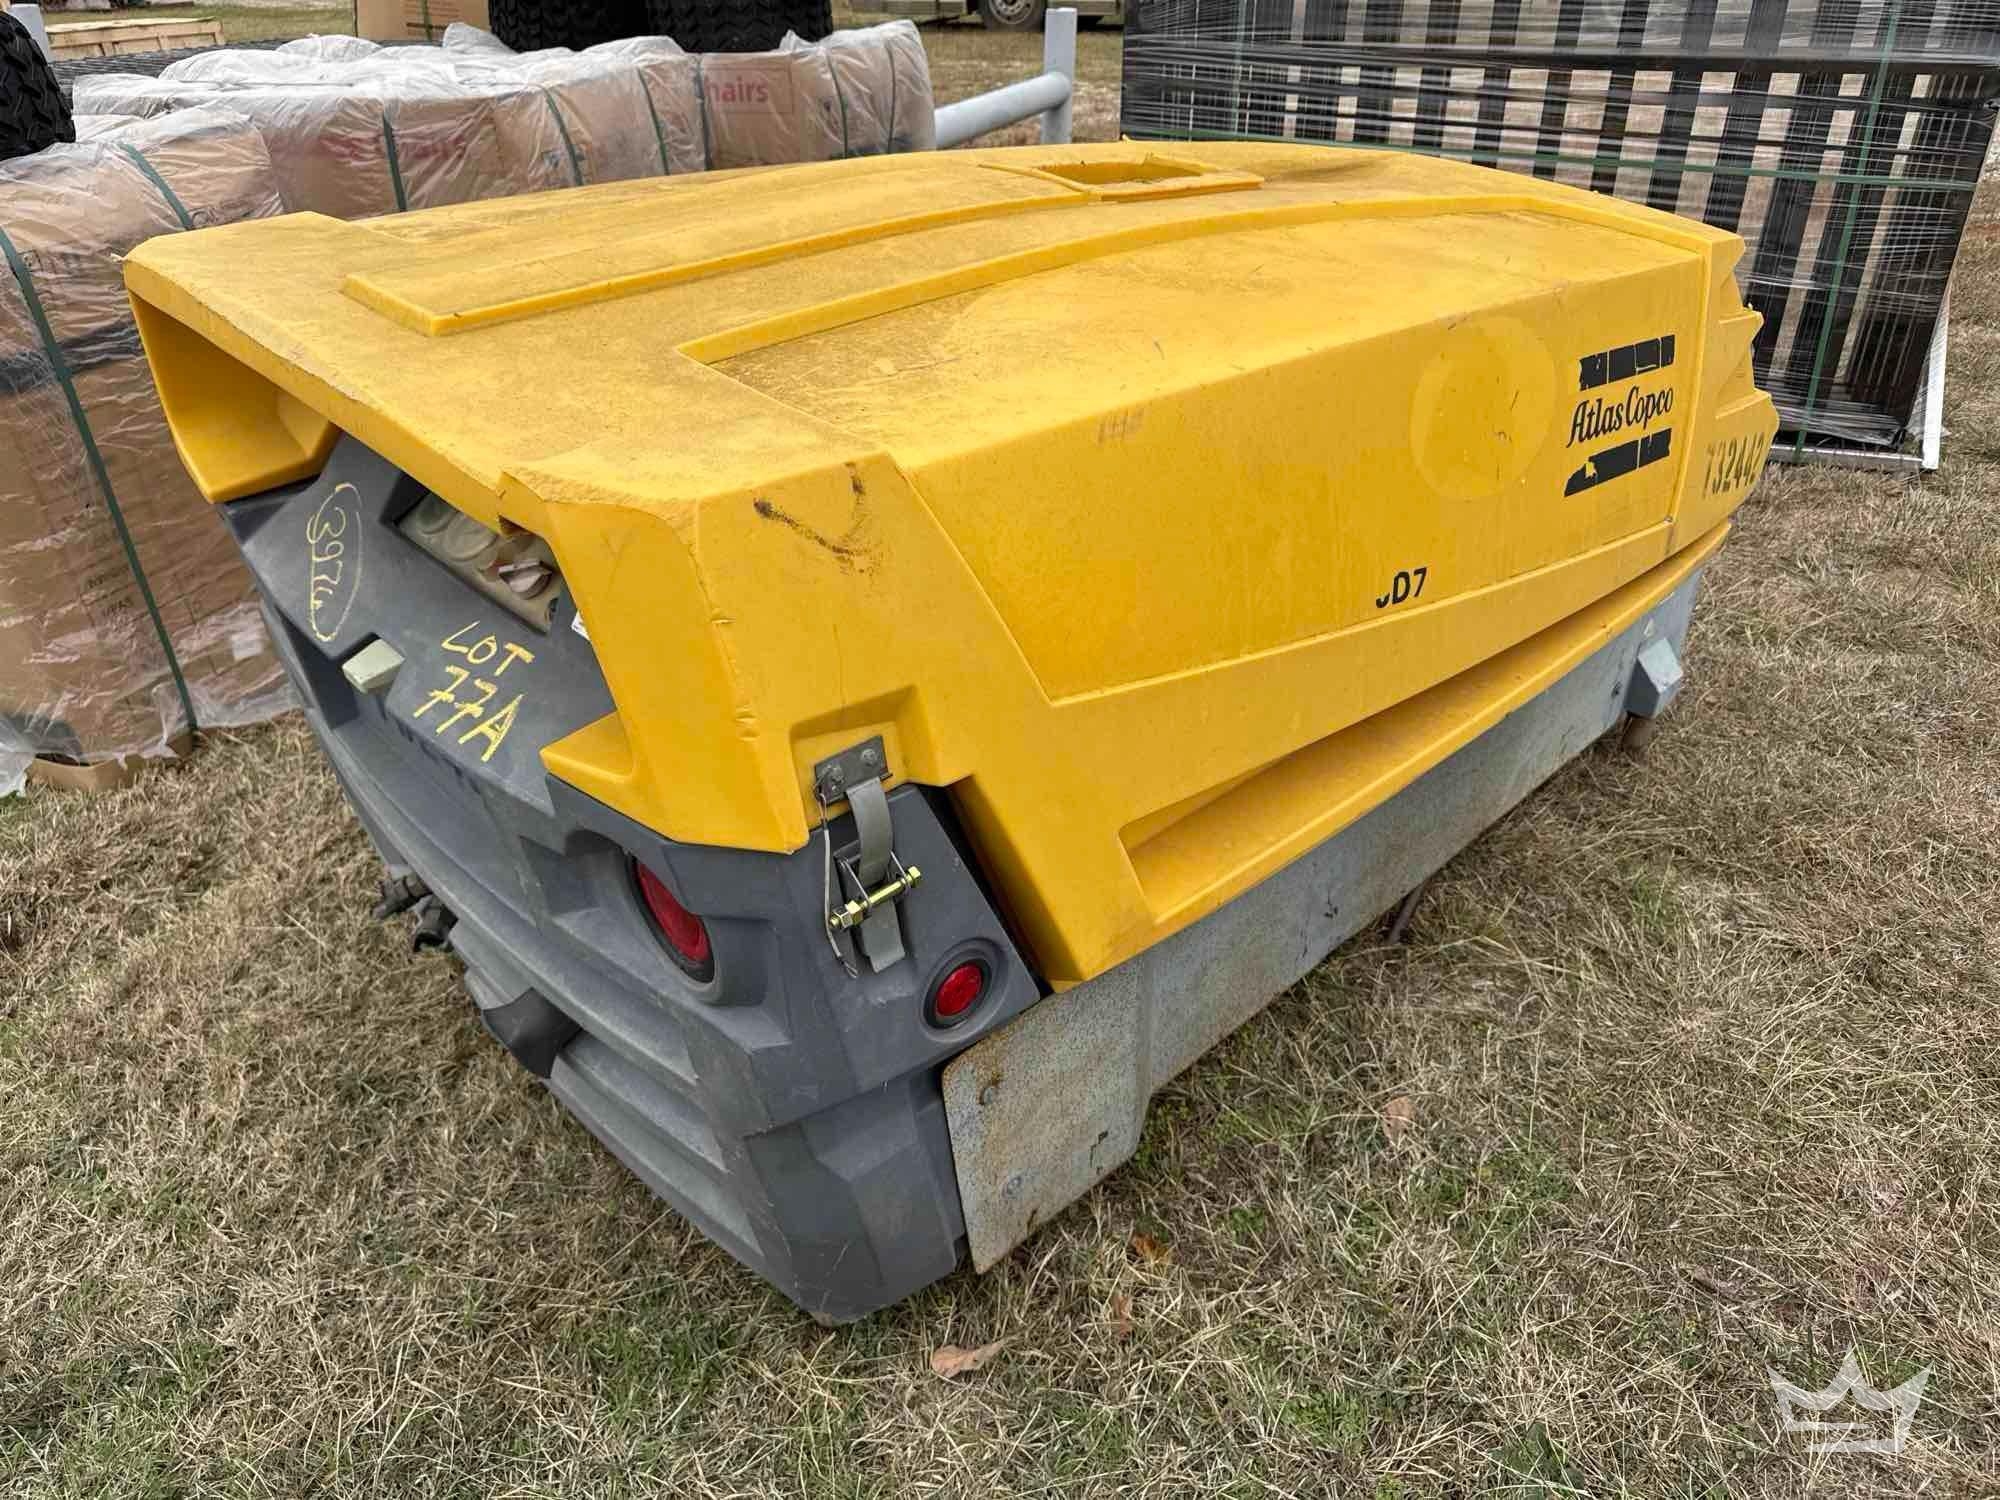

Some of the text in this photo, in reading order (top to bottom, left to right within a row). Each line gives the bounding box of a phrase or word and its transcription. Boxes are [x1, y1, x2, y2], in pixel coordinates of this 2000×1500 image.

[701, 72, 769, 103] hairs
[1566, 386, 1674, 448] Atlas Copco
[441, 620, 535, 677] LOT
[413, 665, 525, 763] 77A
